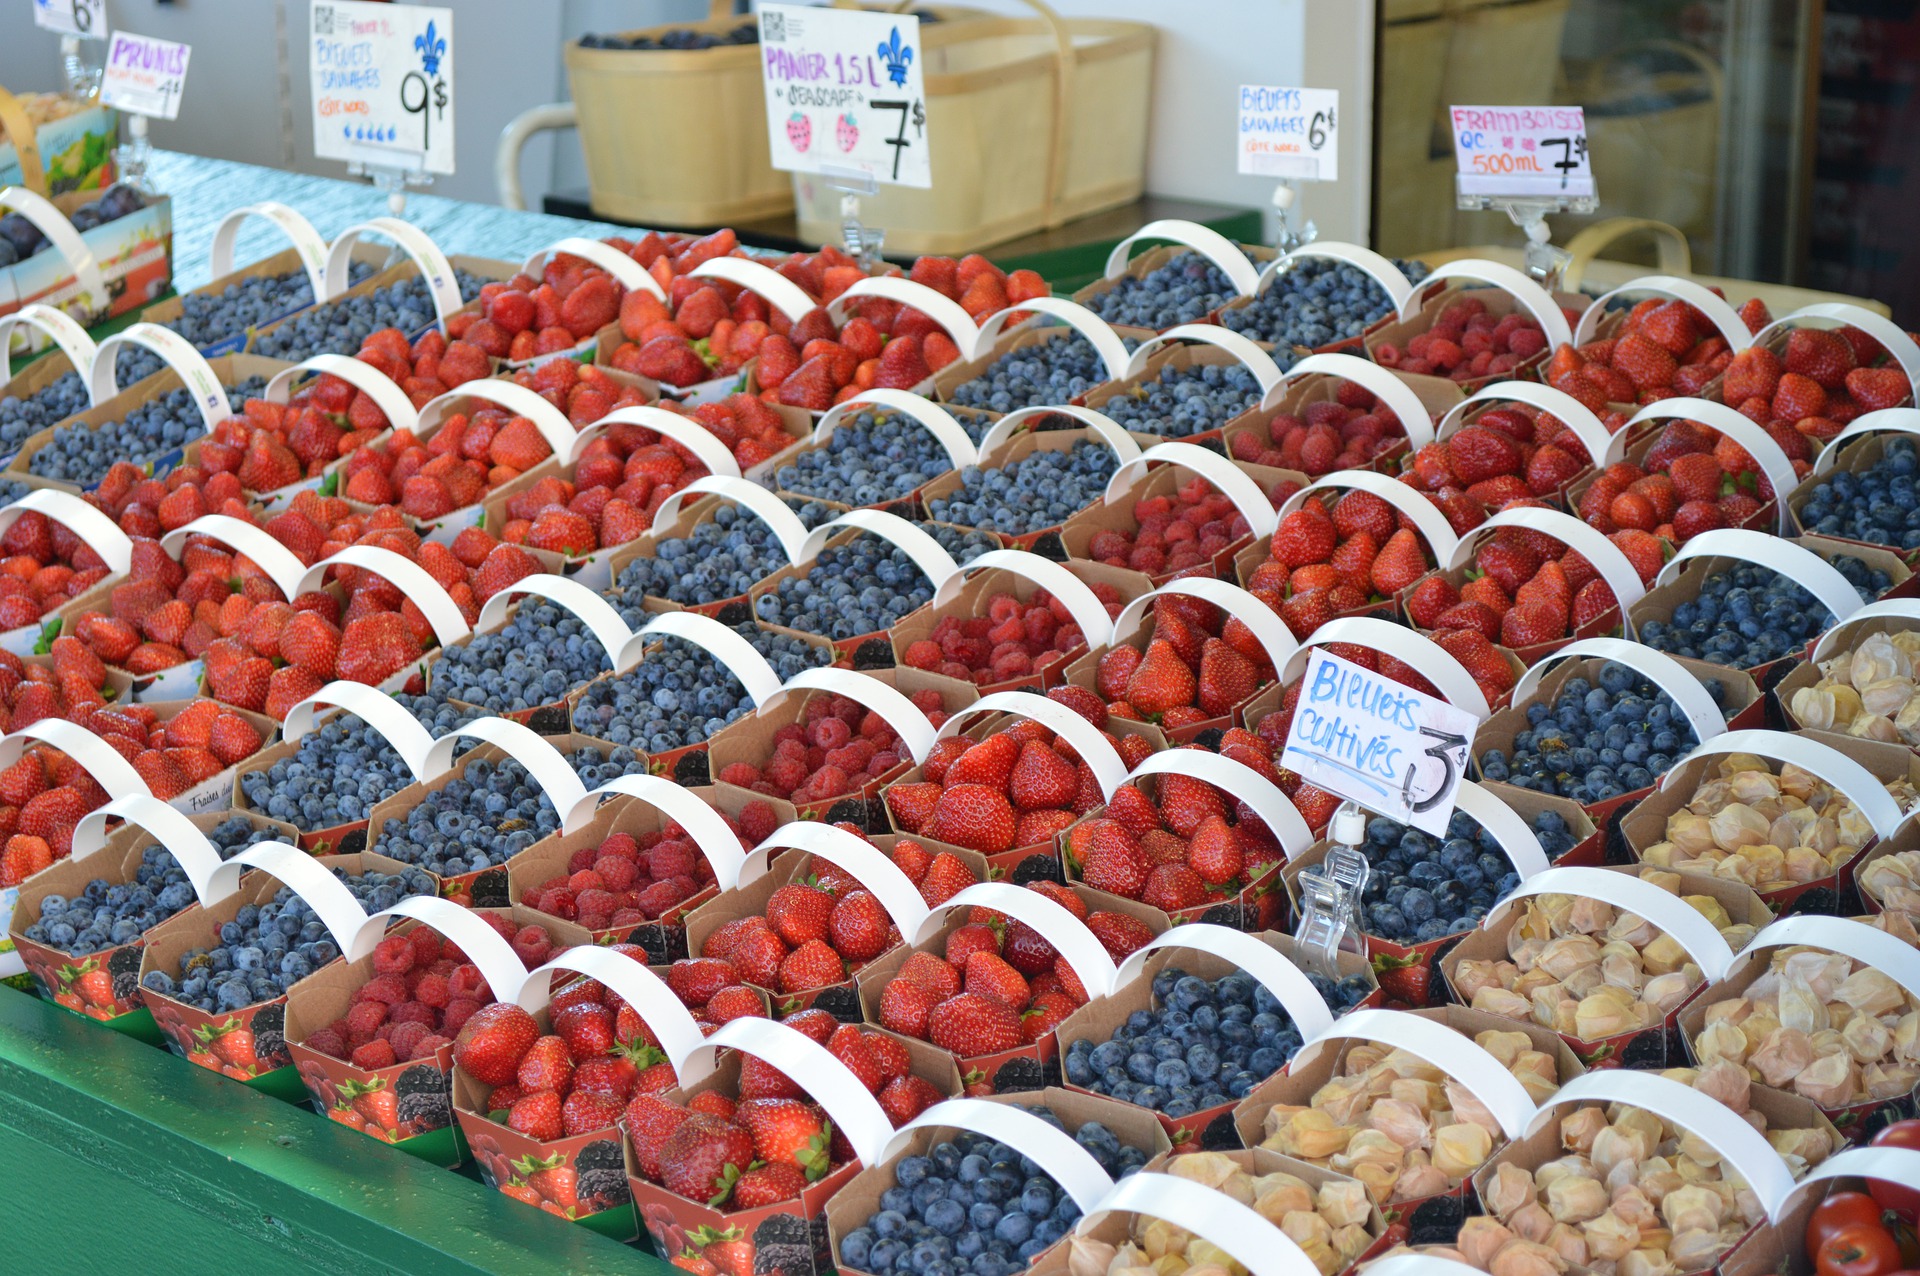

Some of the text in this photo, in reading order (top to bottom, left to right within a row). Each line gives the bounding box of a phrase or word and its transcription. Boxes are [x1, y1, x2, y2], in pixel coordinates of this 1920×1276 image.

[112, 37, 186, 75] PRUNES
[765, 46, 830, 81] PANIER
[834, 53, 864, 85] 1.5
[189, 792, 219, 811] Fraises
